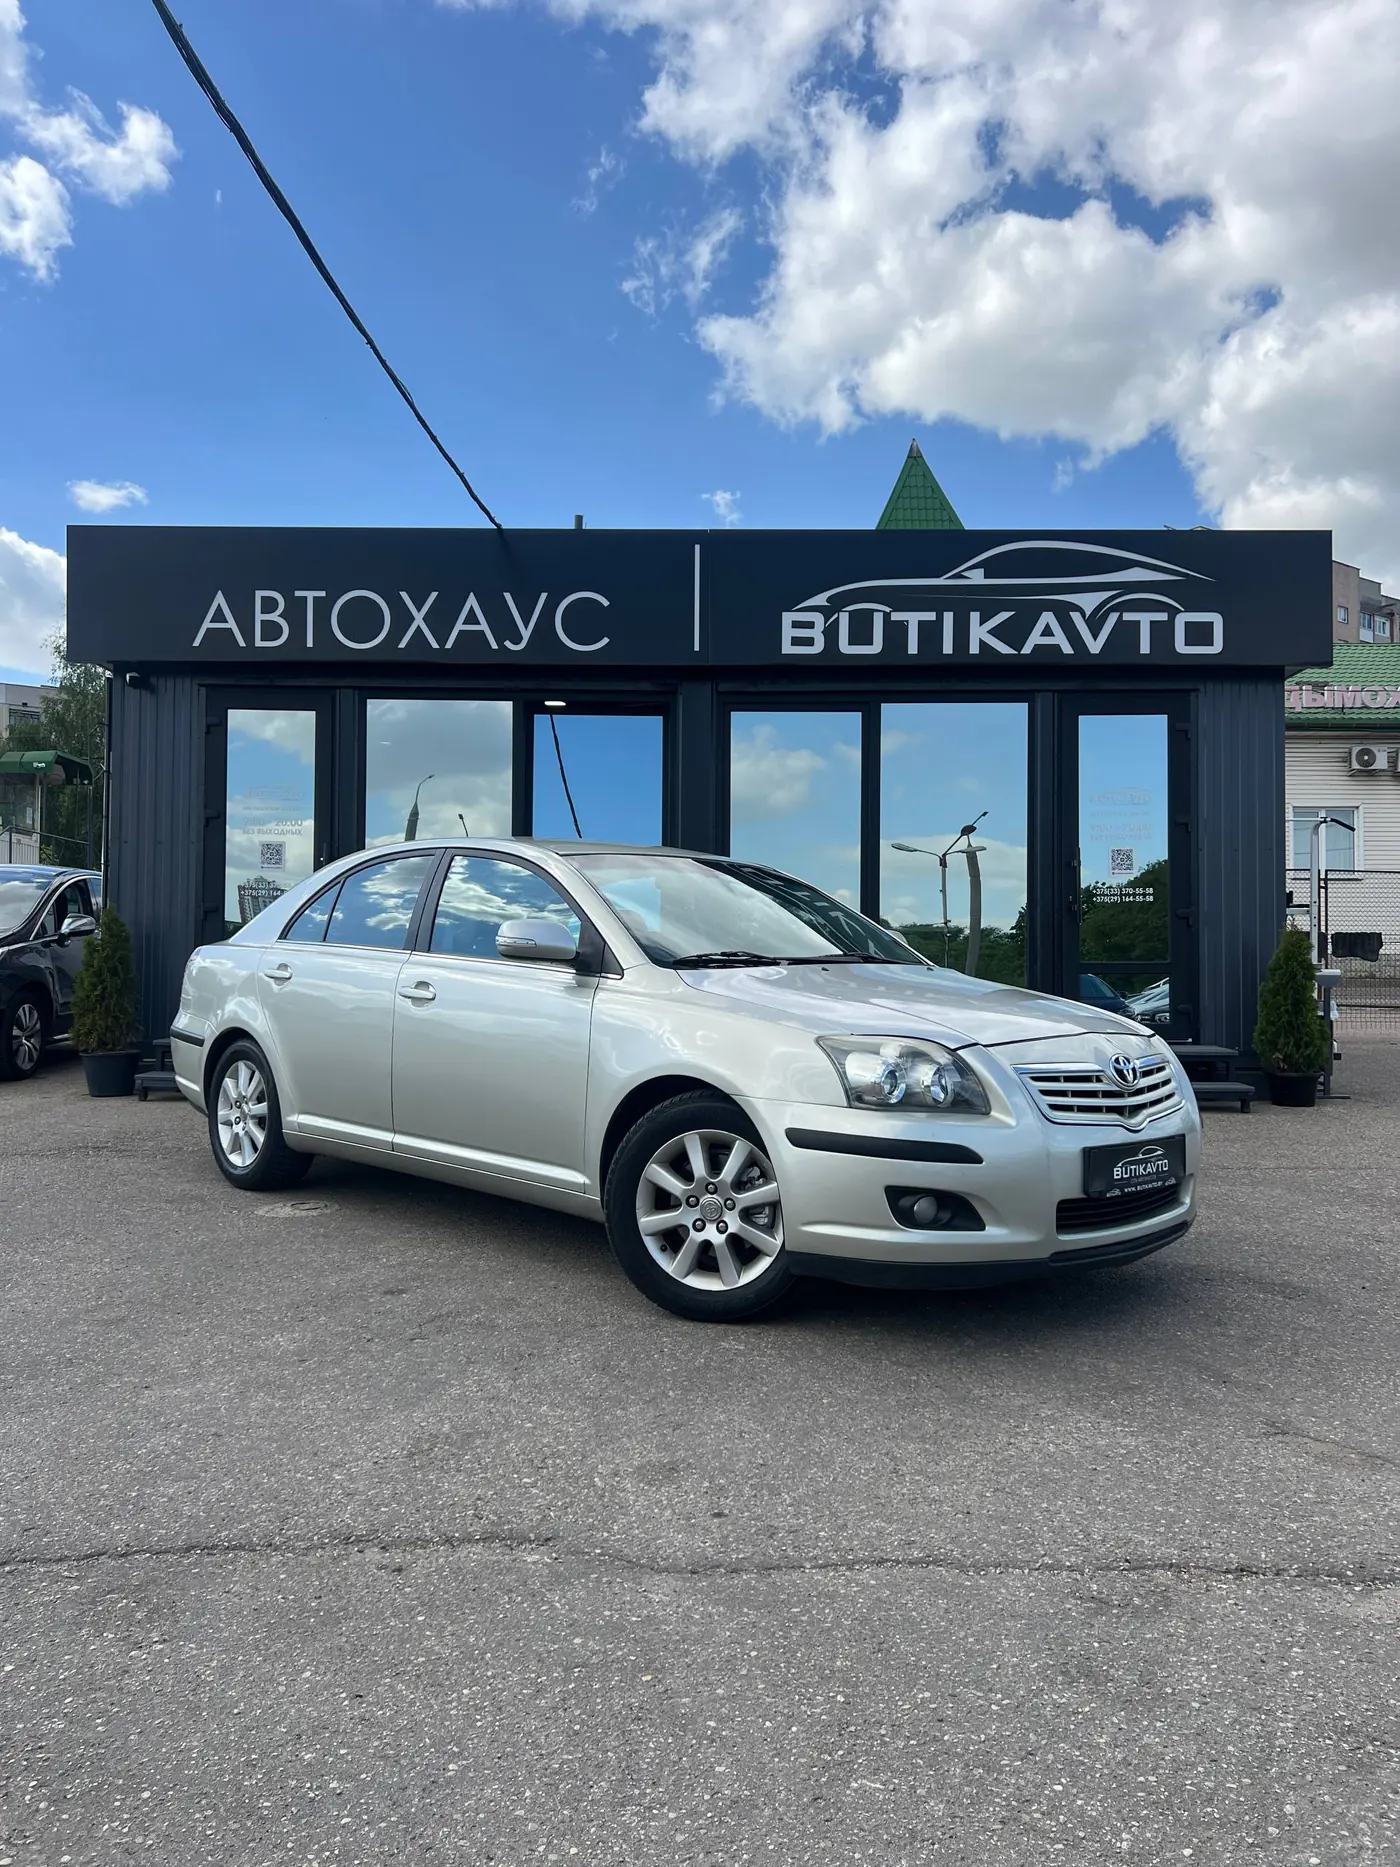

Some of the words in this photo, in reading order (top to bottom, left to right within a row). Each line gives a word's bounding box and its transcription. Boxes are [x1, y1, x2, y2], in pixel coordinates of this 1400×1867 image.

[192, 589, 610, 652] АВТОХАУС
[781, 611, 1224, 655] BUTIKAVTO
[1092, 887, 1120, 895] +375(33)
[1092, 895, 1120, 903] +375(29)
[1113, 1159, 1169, 1179] BUTIKAVTO
